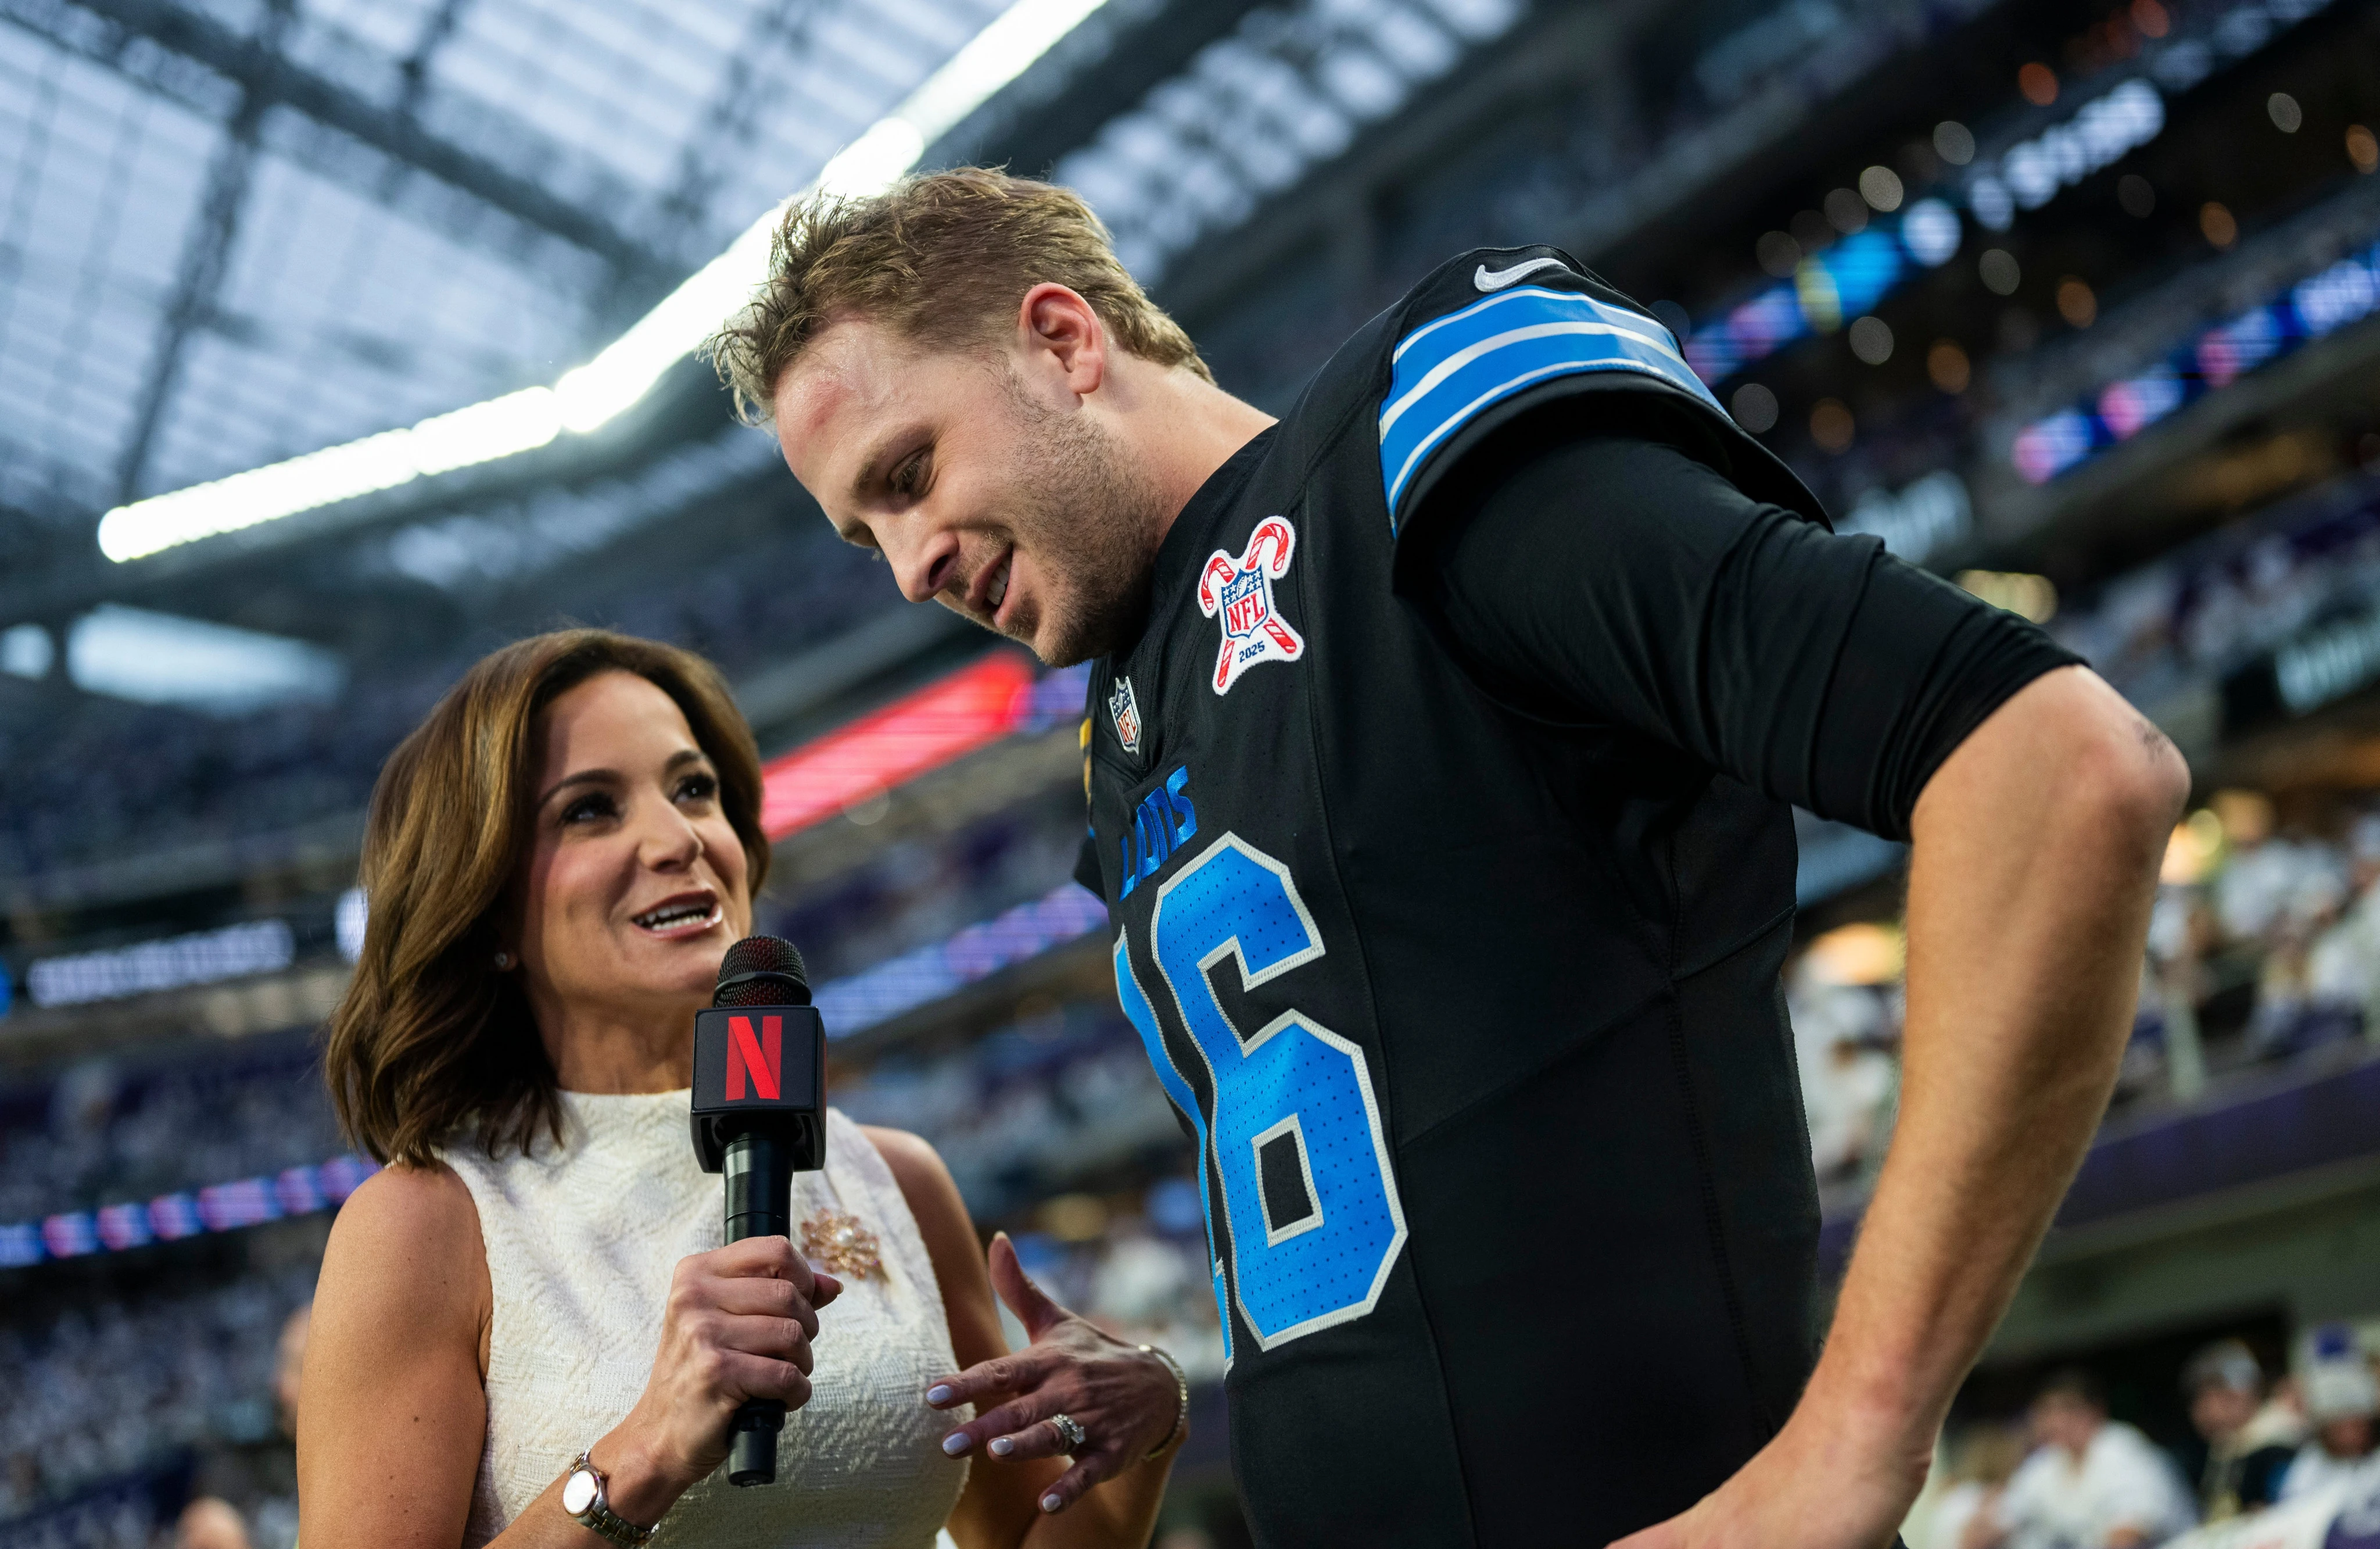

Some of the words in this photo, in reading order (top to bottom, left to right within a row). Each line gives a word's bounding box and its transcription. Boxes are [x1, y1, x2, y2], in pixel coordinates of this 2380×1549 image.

[1227, 592, 1264, 632] NFL
[1239, 641, 1265, 663] 2025
[1118, 709, 1137, 743] NFL
[725, 1015, 783, 1101] N
